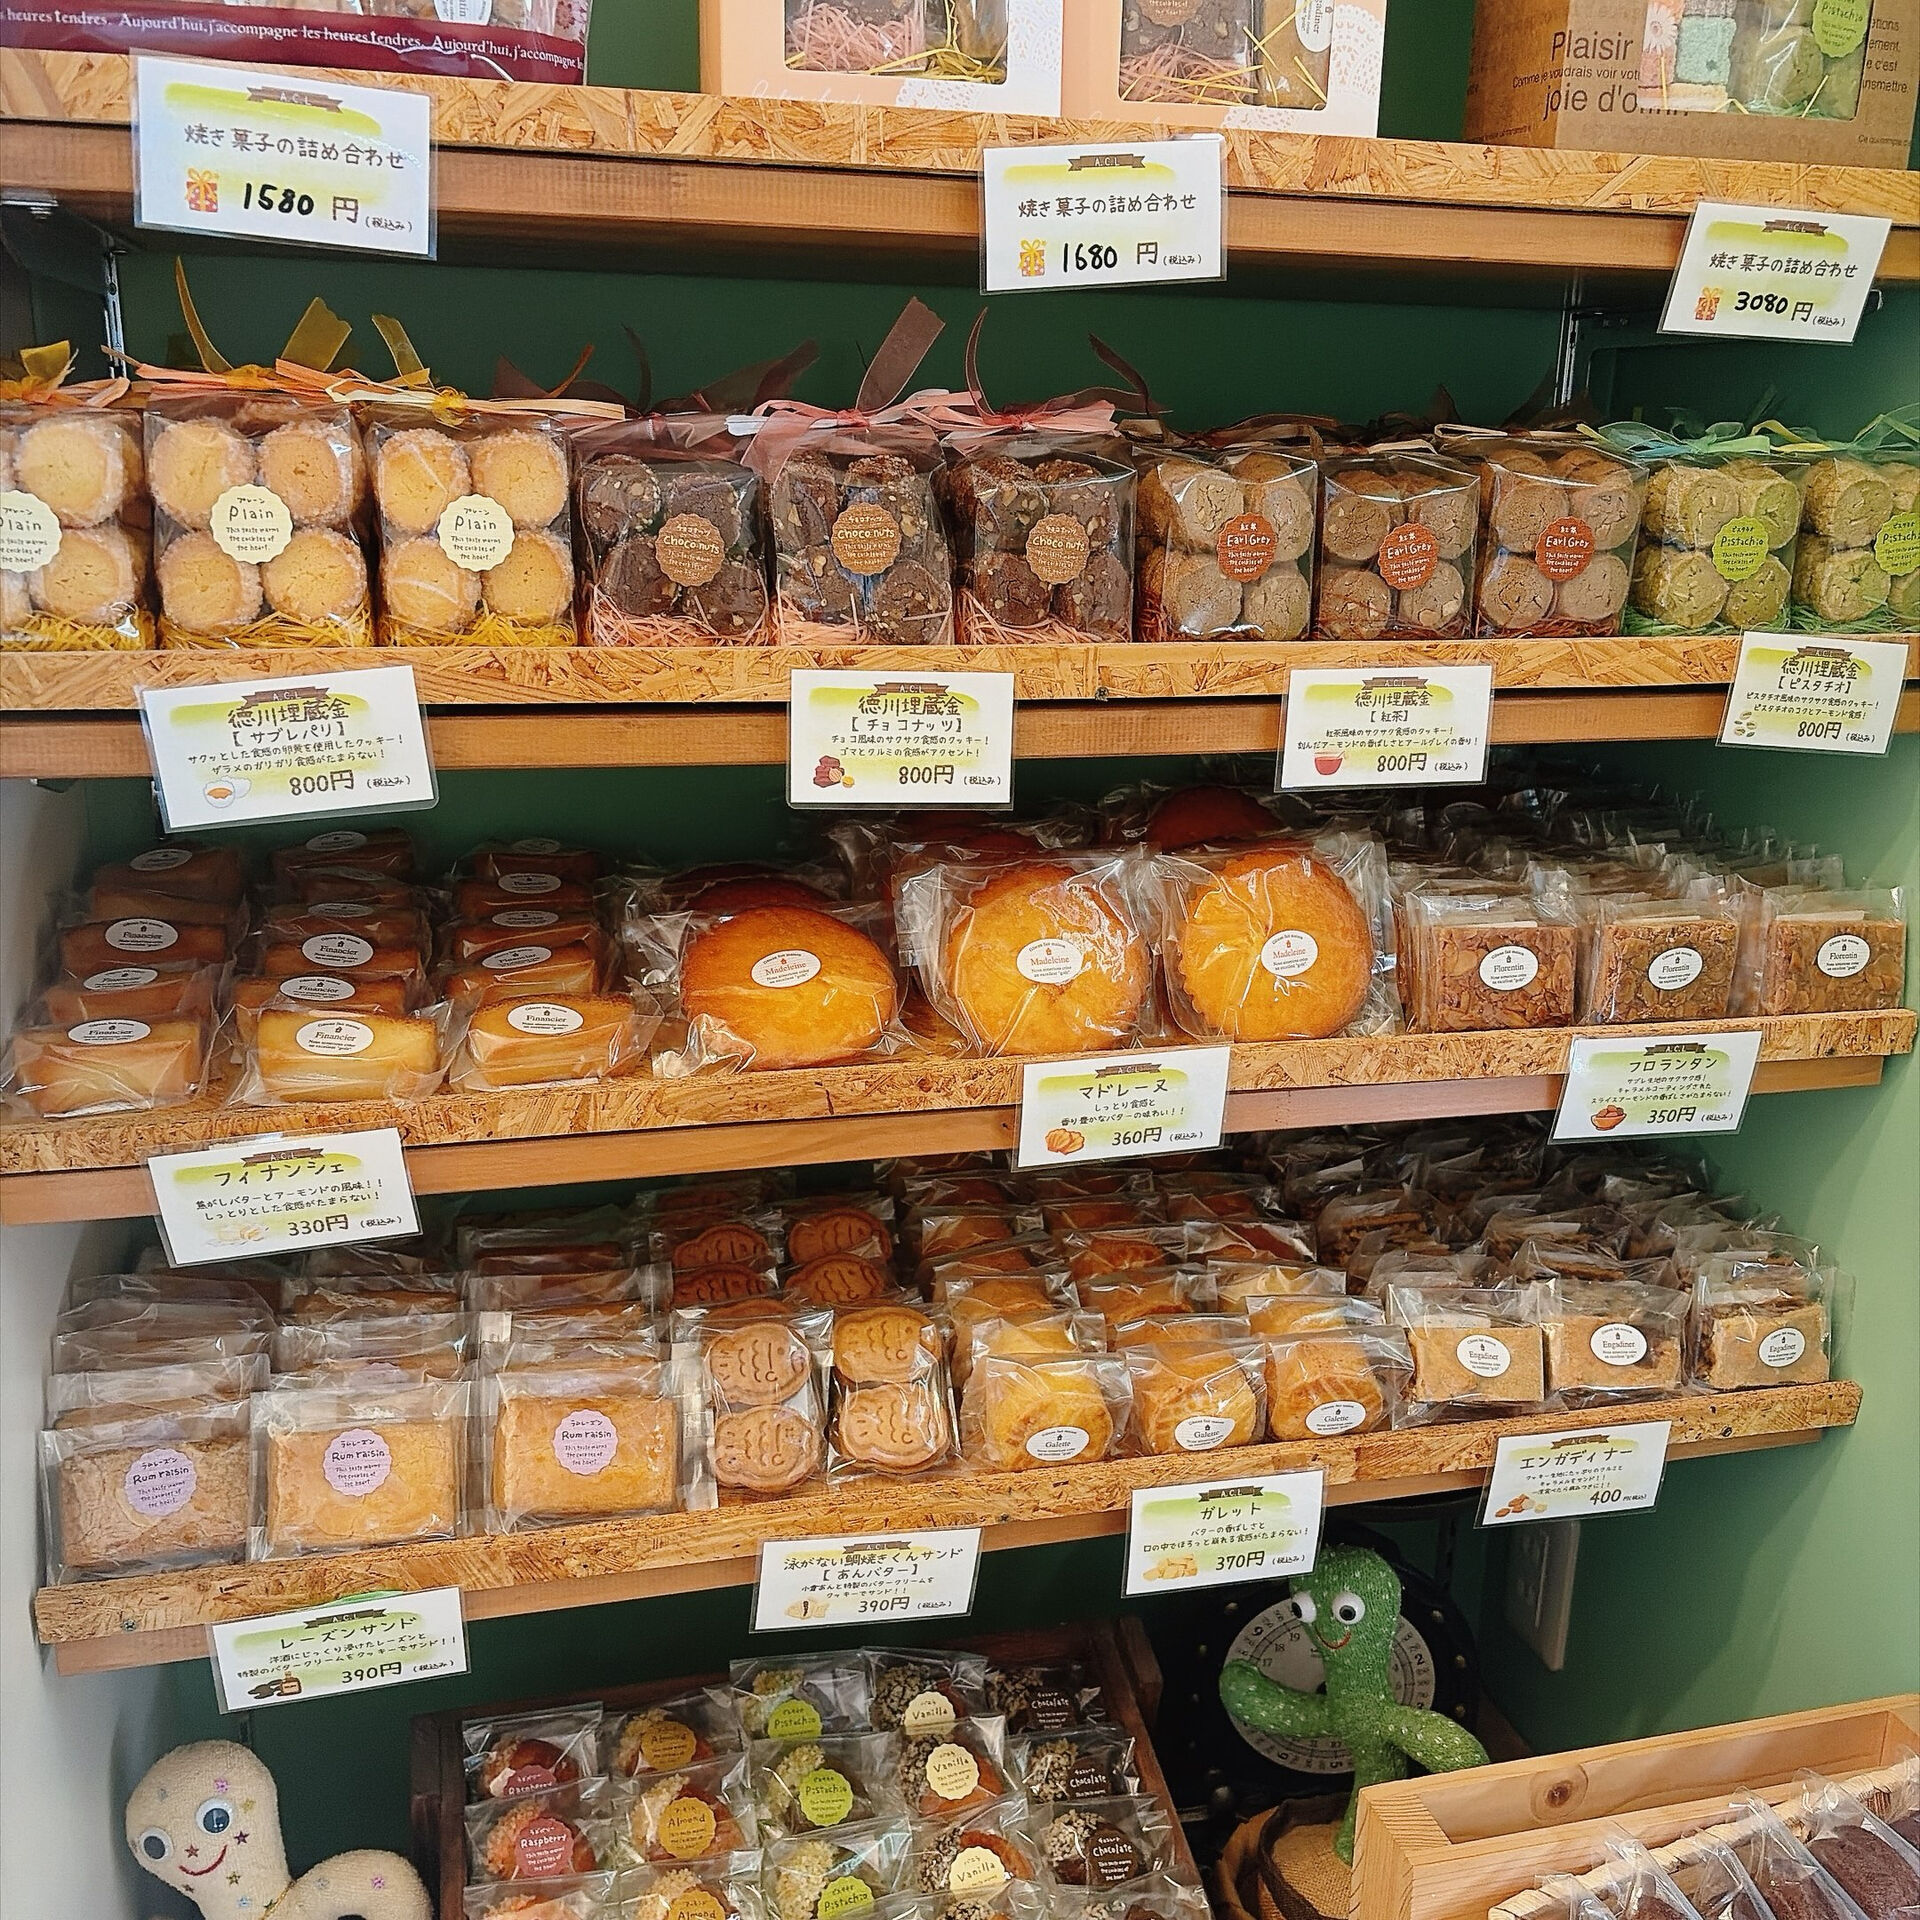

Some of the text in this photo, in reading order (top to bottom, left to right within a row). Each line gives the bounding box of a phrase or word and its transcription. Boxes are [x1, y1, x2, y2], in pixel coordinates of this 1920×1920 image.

[1551, 31, 1633, 62] Plaisir
[1549, 66, 1592, 82] voudrais
[1597, 67, 1617, 79] voir
[1543, 84, 1587, 121] joie
[184, 122, 404, 169] 焼き菓子の詰め合わせ
[243, 183, 314, 215] 1580
[332, 196, 359, 223] 円
[1018, 193, 1197, 218] 焼き菓子の詰め合わせ
[1063, 242, 1118, 272] 1680
[1136, 241, 1158, 265] 円
[1709, 252, 1858, 278] 焼き菓子の詰め合わせ
[1734, 291, 1789, 315] 3080
[1791, 301, 1813, 322] 円
[229, 505, 274, 522] Plain
[455, 515, 497, 532] Plain
[1226, 533, 1271, 547] Earl Grey
[1545, 535, 1590, 549] Earl Grey
[1720, 535, 1764, 547] Pistachio
[1387, 543, 1432, 559] Earl Grey
[1780, 657, 1862, 680] 徳川埋蔵金
[858, 696, 964, 717] 徳川埋蔵金
[1354, 690, 1433, 708] 徳川埋蔵金
[227, 698, 351, 729] 徳川埋蔵金
[1797, 721, 1843, 740] 800円
[1377, 753, 1428, 773] 800円
[289, 769, 355, 797] 800円
[899, 764, 955, 785] 800円
[1030, 956, 1070, 966] Madeleine
[1271, 947, 1306, 959] Madeleine
[764, 961, 807, 976] Madeleine
[1494, 963, 1525, 973] Florentin
[1662, 963, 1690, 973] Florentin
[525, 1014, 567, 1023] Financier
[314, 1031, 357, 1042] Financier
[1630, 1057, 1718, 1073] フロランタン
[1079, 1079, 1168, 1100] マドレーヌ
[1646, 1106, 1697, 1124] 350円
[1111, 1126, 1162, 1146] 360円
[214, 1159, 345, 1187] フィナンシェ
[288, 1213, 349, 1237] 330円
[1602, 1340, 1635, 1351] Engadiner
[1468, 1350, 1499, 1361] Engadiner
[1323, 1413, 1350, 1422] Galette
[562, 1430, 612, 1441] Rum raisin
[1193, 1430, 1220, 1439] Galette
[1045, 1439, 1072, 1449] Galette
[332, 1449, 385, 1463] Rum raisin
[1519, 1447, 1633, 1470] エンガディナー
[132, 1467, 189, 1487] Rum raisin
[1589, 1489, 1622, 1506] 400
[1200, 1502, 1262, 1521] ガレット
[1216, 1550, 1265, 1571] 370円
[858, 1597, 910, 1614] 390円
[280, 1616, 417, 1649] レーズンサンド
[342, 1661, 402, 1684] 390円
[1031, 1698, 1070, 1709] Chocolate
[774, 1716, 816, 1730] Pistachio
[912, 1708, 948, 1722] Vanilla
[933, 1756, 970, 1775] Vanilla
[1069, 1774, 1107, 1788] Chocolate
[805, 1783, 847, 1797] Pistachio
[667, 1815, 705, 1829] Almond
[520, 1834, 567, 1849] Raspberry
[1092, 1843, 1133, 1858] Chocolate
[957, 1862, 995, 1882] Vanilla
[824, 1892, 868, 1912] Pistachio
